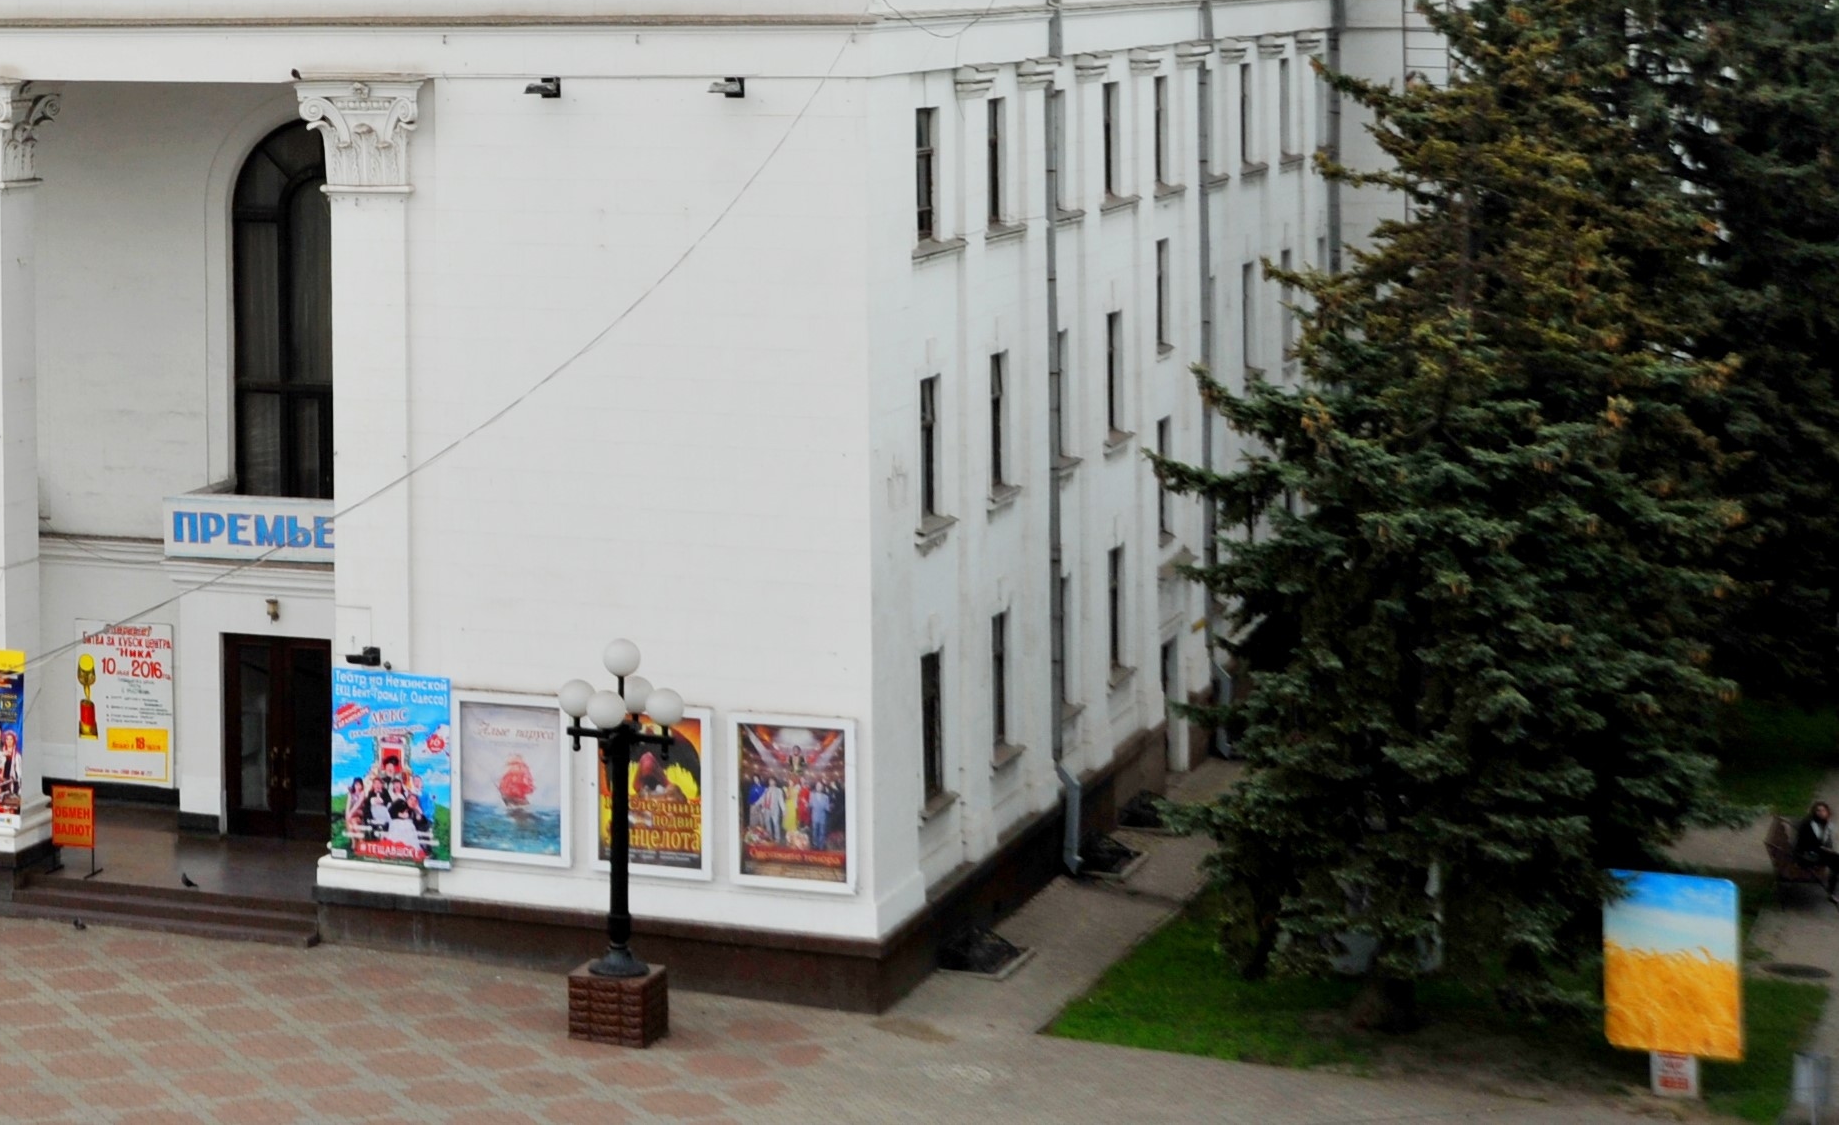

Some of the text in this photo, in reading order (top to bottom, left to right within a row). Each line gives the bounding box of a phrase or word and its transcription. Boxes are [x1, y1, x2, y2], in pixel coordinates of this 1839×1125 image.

[101, 657, 116, 675] 10
[131, 659, 163, 679] 2016
[335, 670, 367, 688] Театр
[385, 675, 448, 692] Нежинской
[54, 806, 90, 820] ОБМЕН
[54, 822, 91, 836] ВАЛЮТ
